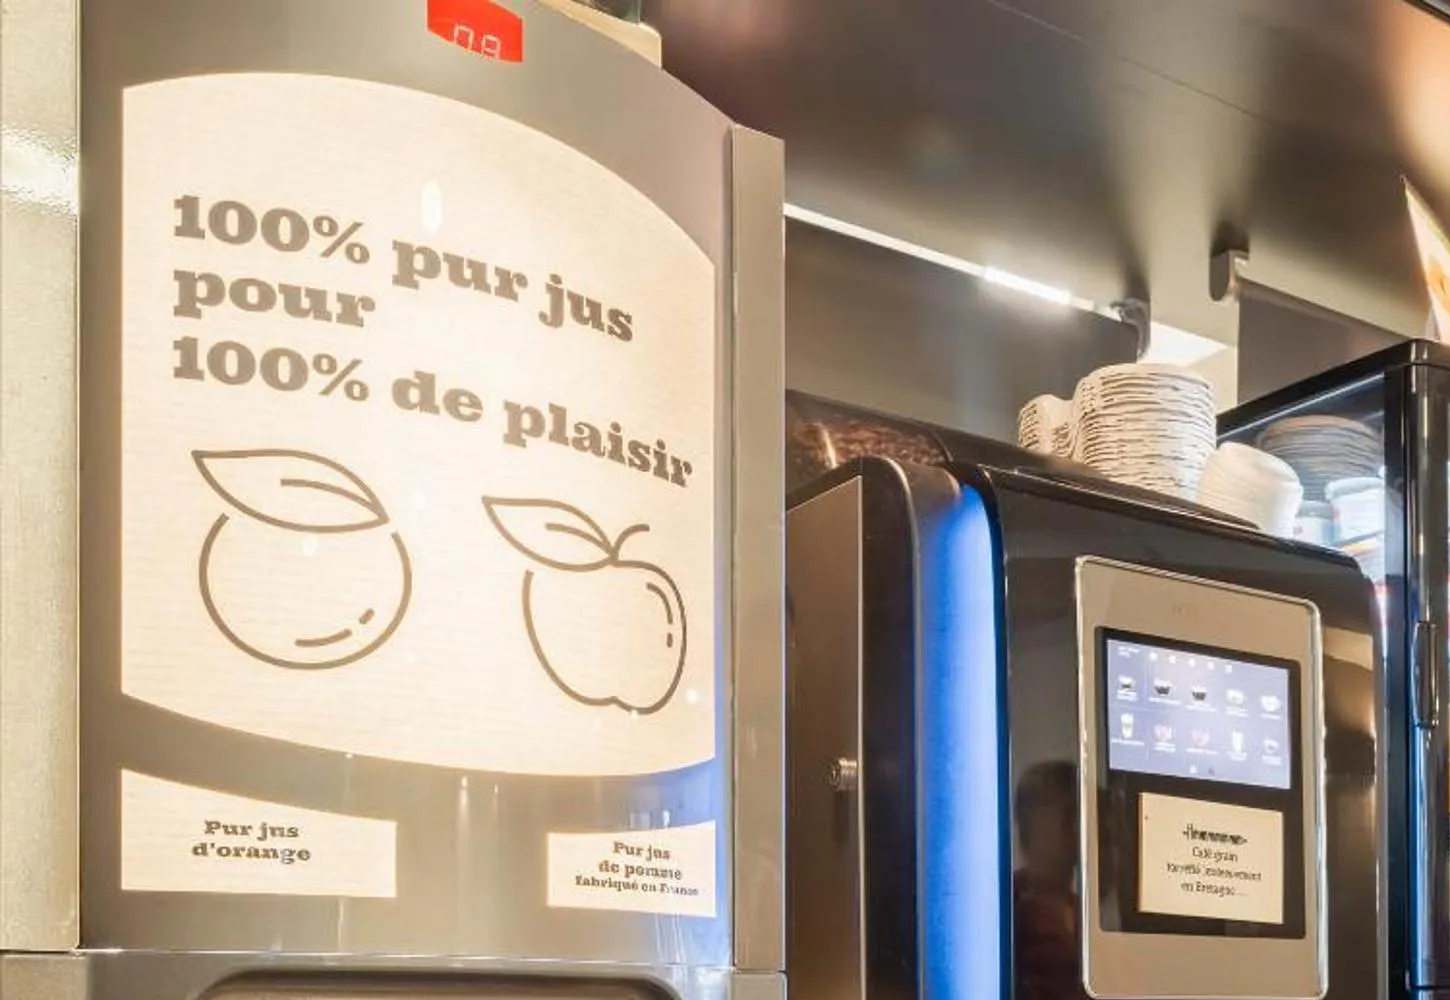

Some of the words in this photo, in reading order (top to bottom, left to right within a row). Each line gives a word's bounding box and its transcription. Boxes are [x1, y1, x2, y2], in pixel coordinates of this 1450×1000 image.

[173, 194, 370, 265] 100%
[392, 239, 529, 302] pur
[538, 273, 634, 342] jus
[172, 269, 376, 328] pour
[172, 335, 370, 402] 100%
[391, 370, 484, 423] de
[502, 399, 694, 488] plaisir
[203, 818, 253, 836] Pur
[256, 821, 300, 842] jus
[191, 841, 312, 866] d'orange
[612, 840, 644, 856] Pur
[598, 859, 620, 873] de
[624, 865, 683, 881] pomme
